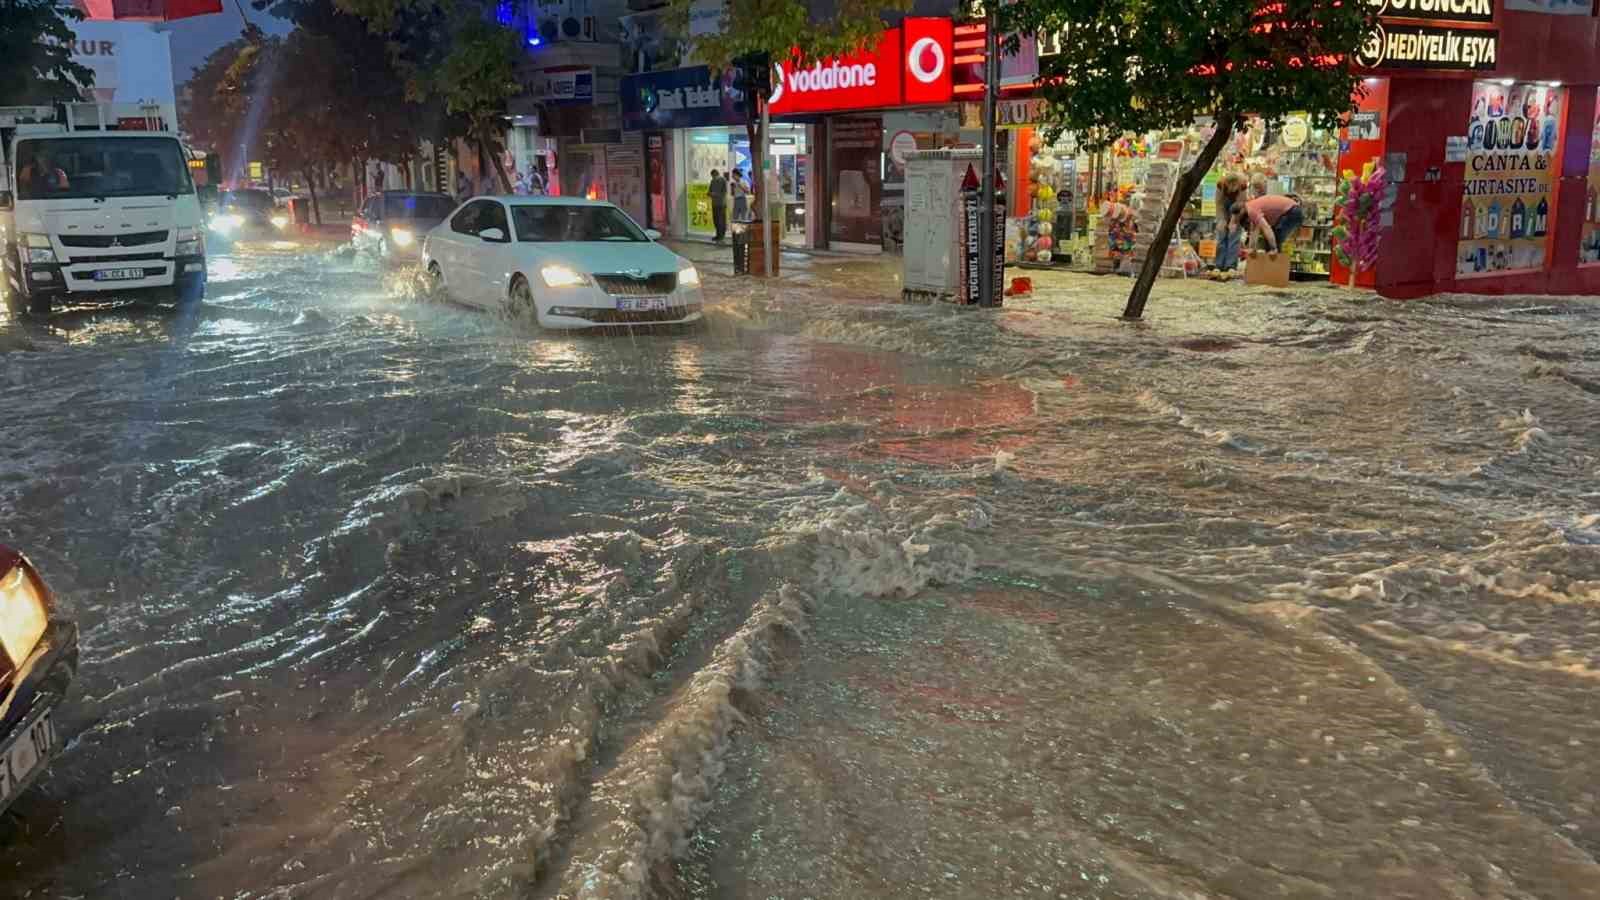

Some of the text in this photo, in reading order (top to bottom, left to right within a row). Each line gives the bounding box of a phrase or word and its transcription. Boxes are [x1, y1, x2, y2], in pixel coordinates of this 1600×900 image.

[1386, 29, 1496, 68] HEDİYELİK EŞYA
[787, 60, 876, 93] vodafone
